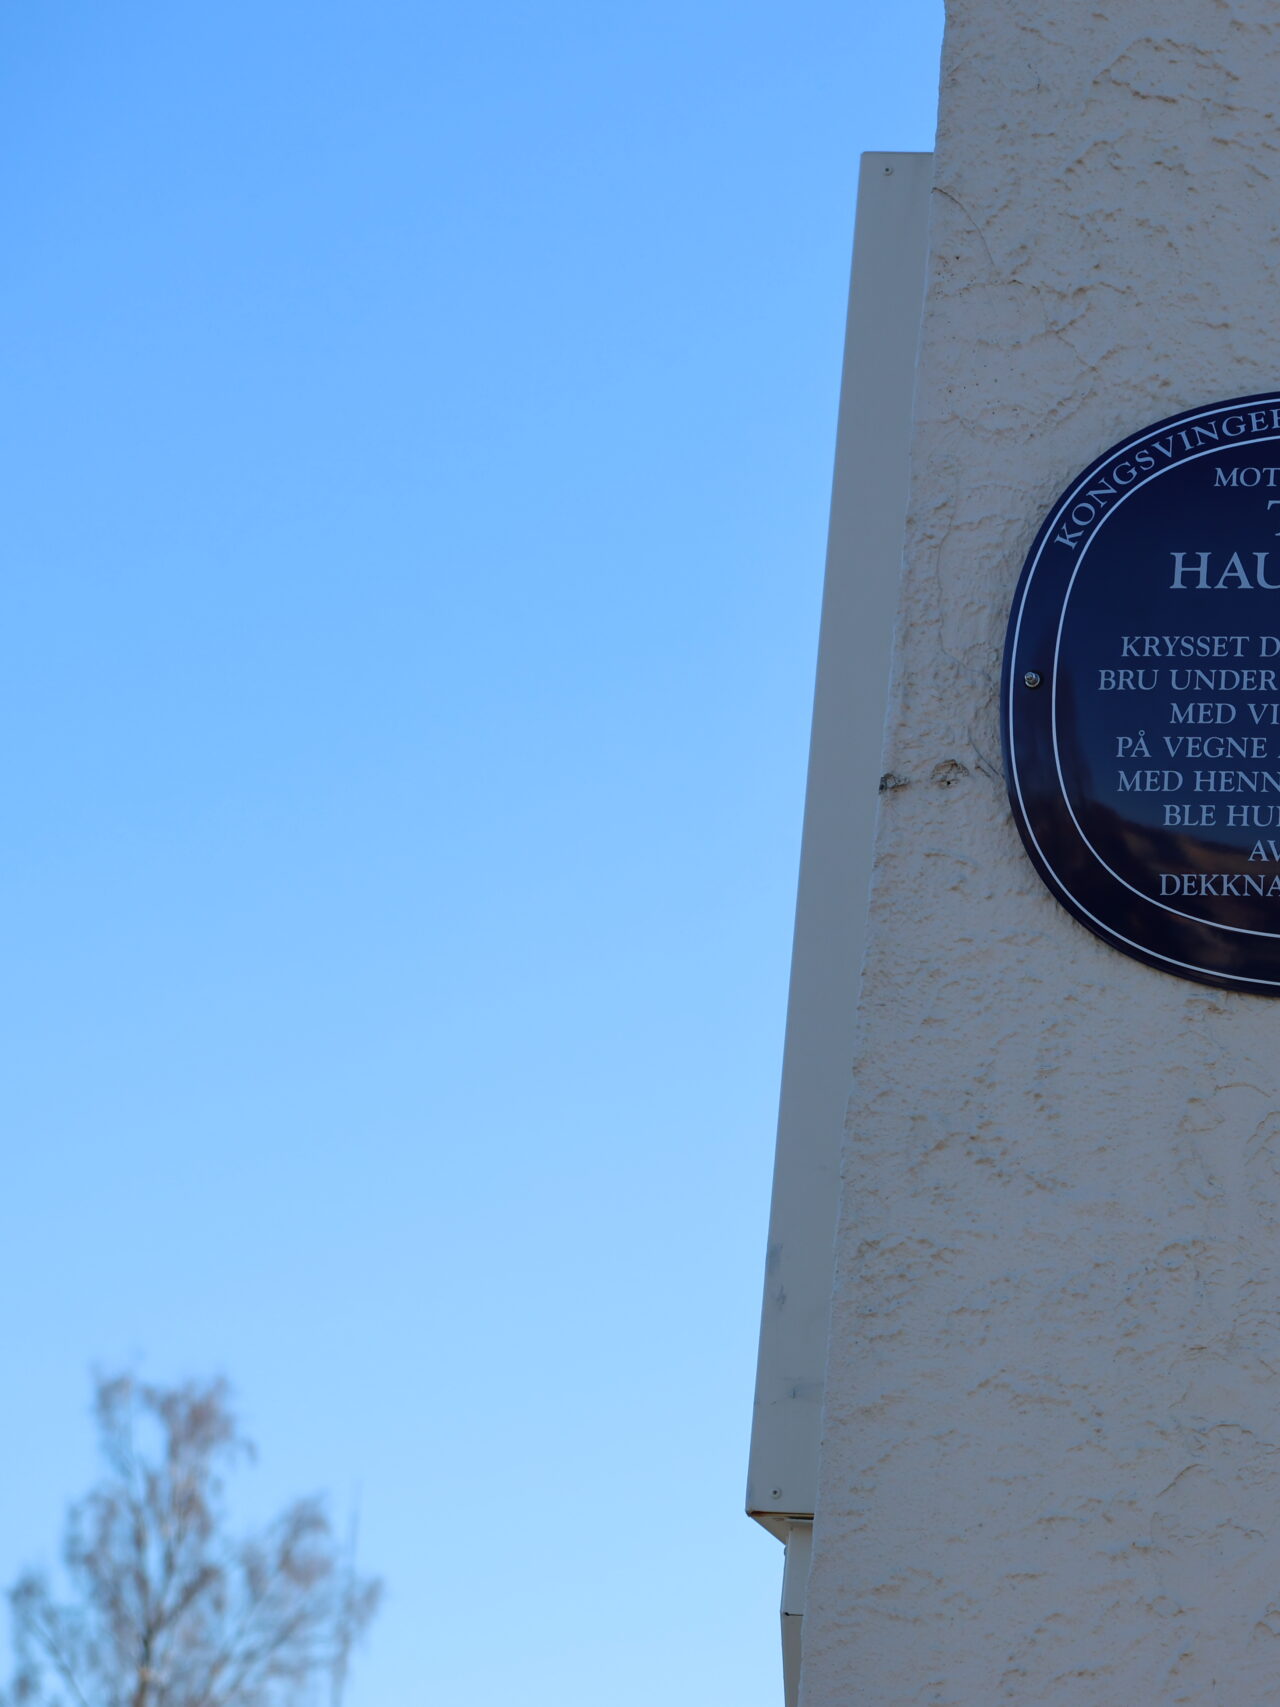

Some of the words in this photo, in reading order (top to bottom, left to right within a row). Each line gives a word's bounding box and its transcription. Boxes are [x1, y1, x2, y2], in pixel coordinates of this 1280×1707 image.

[1121, 635, 1250, 658] KRYSSET
[1098, 669, 1159, 691] BRU
[1169, 669, 1278, 692] UNDER
[1169, 702, 1237, 725] MED
[1116, 729, 1152, 758] PÅ
[1163, 736, 1268, 759] VEGNE
[1117, 770, 1183, 792] MED
[1163, 804, 1216, 826] BLE
